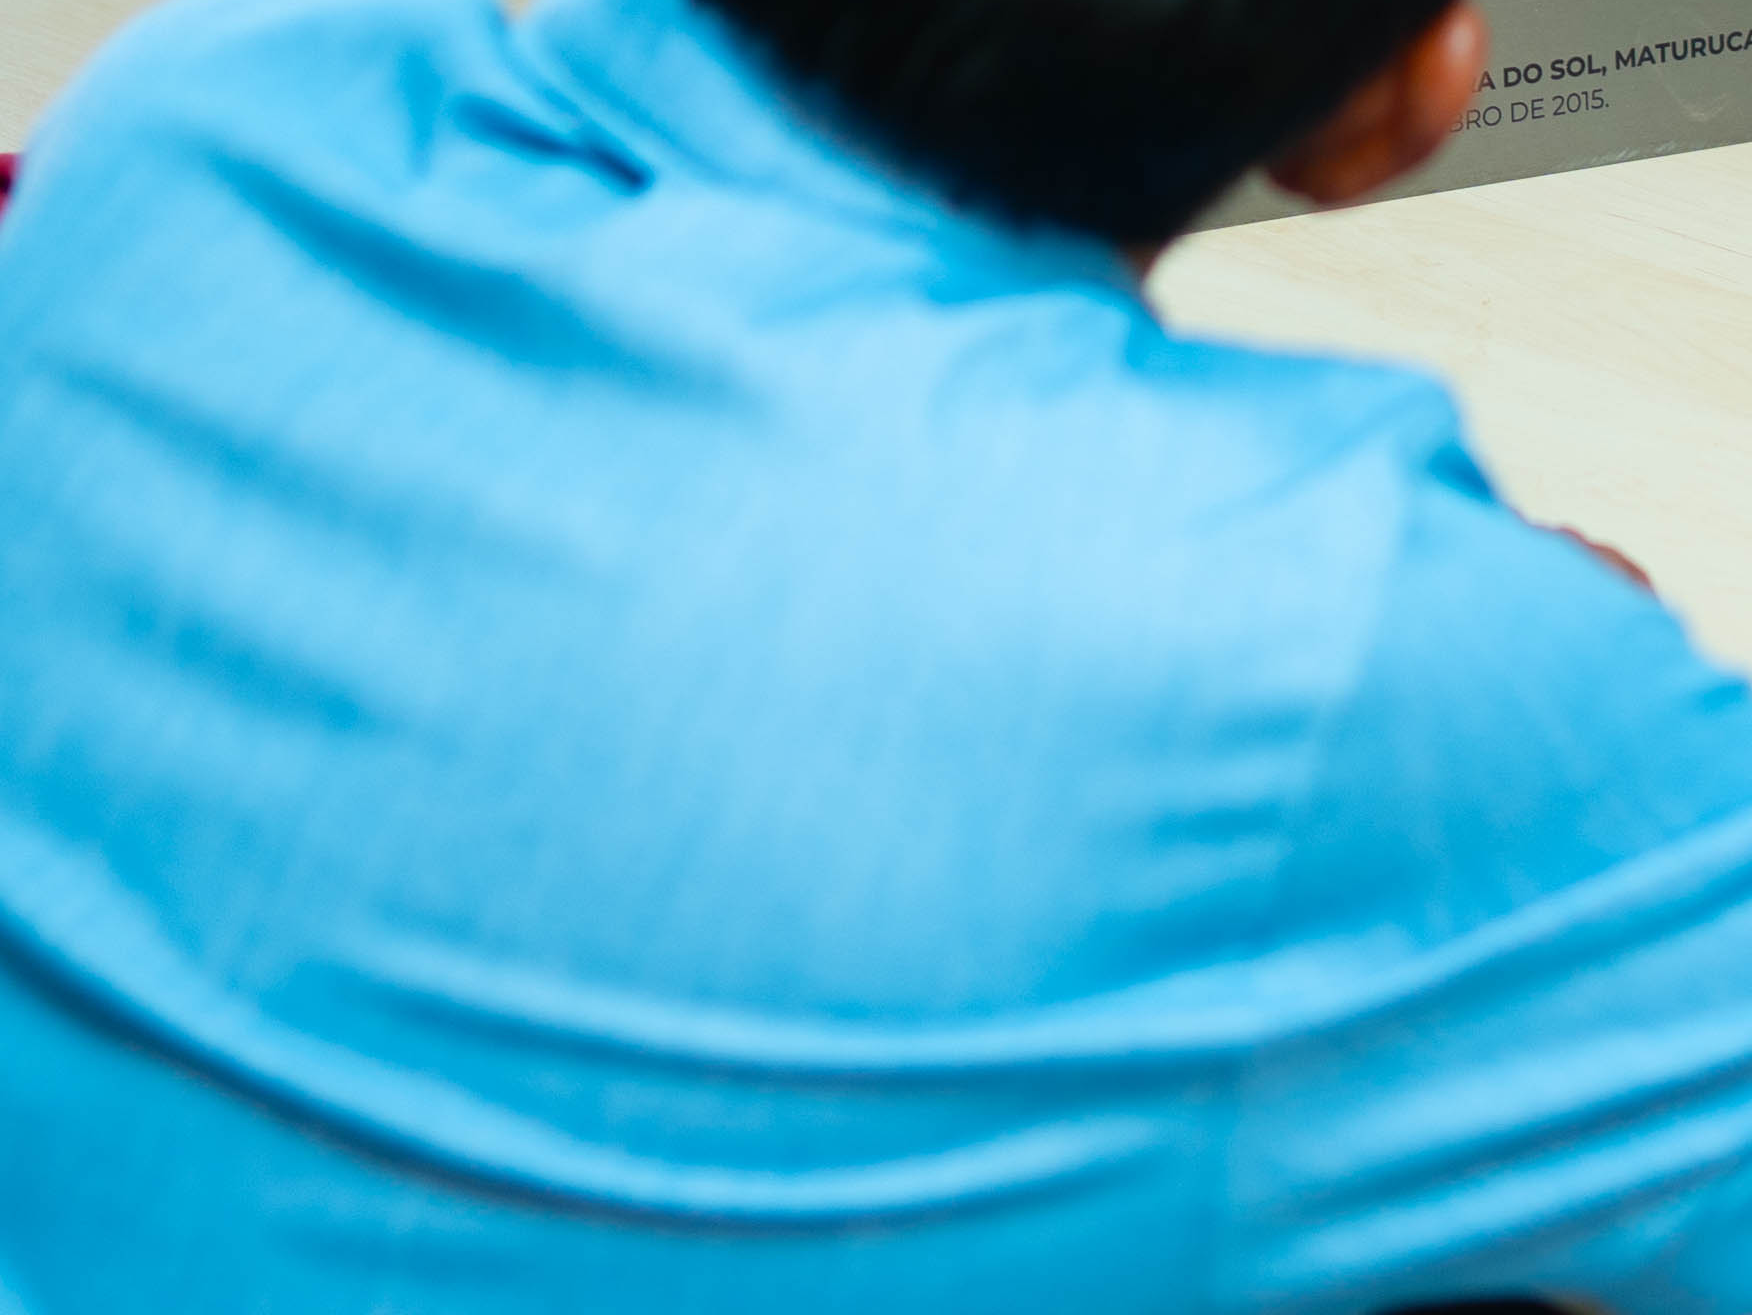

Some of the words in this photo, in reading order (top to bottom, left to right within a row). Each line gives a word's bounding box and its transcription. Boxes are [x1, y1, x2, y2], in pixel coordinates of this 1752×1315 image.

[1503, 62, 1543, 89] DO
[1549, 54, 1607, 80] SOL,
[1510, 98, 1546, 124] DE
[1552, 88, 1610, 118] 2015.
